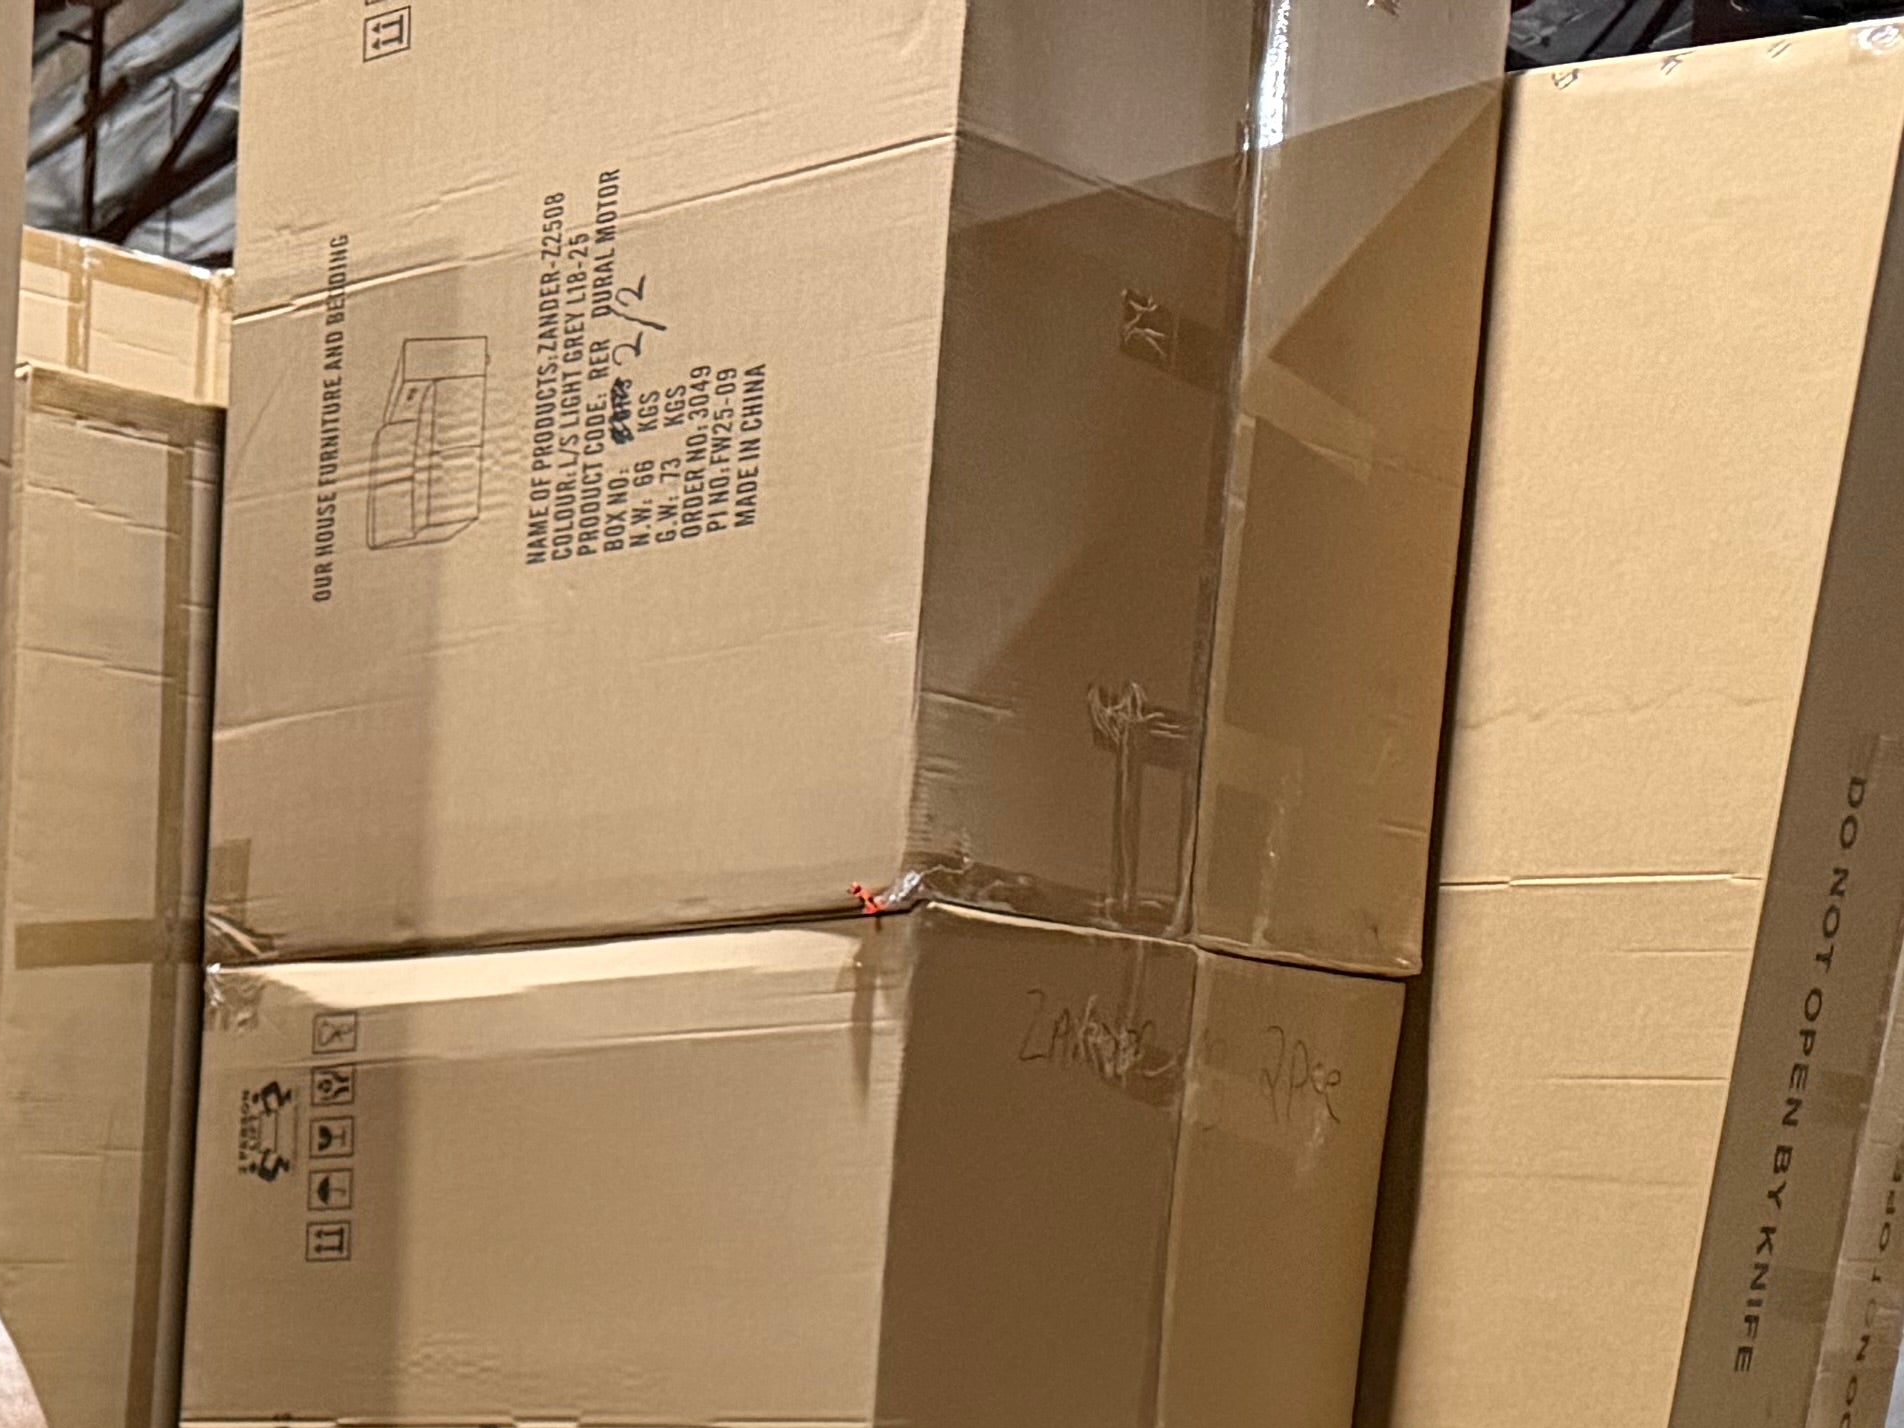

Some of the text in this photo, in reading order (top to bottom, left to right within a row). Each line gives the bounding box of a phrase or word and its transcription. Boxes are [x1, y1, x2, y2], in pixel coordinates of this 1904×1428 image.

[323, 331, 344, 372] AND
[612, 274, 667, 366] 2/2
[550, 232, 591, 561] COLOUR:L/S LIGHT GREY L18-25
[576, 168, 620, 556] PRODUCT CODE: RER DURAL MOTOR
[317, 376, 342, 489] FURNITURE
[629, 389, 661, 548] N.W: 66 KGS
[655, 384, 687, 543] G.W: 73 KGS
[734, 363, 767, 528] MADE IN CHINA
[529, 478, 552, 502] OF
[607, 468, 630, 505] NO:
[680, 467, 706, 539] ORDER
[706, 511, 729, 533] PI
[315, 491, 337, 557] HOUSE
[525, 506, 550, 566] NAME
[603, 509, 627, 553] BOX
[312, 563, 333, 602] OUR
[1733, 775, 1868, 1373] DO NOT OPEN BY KNIFE
